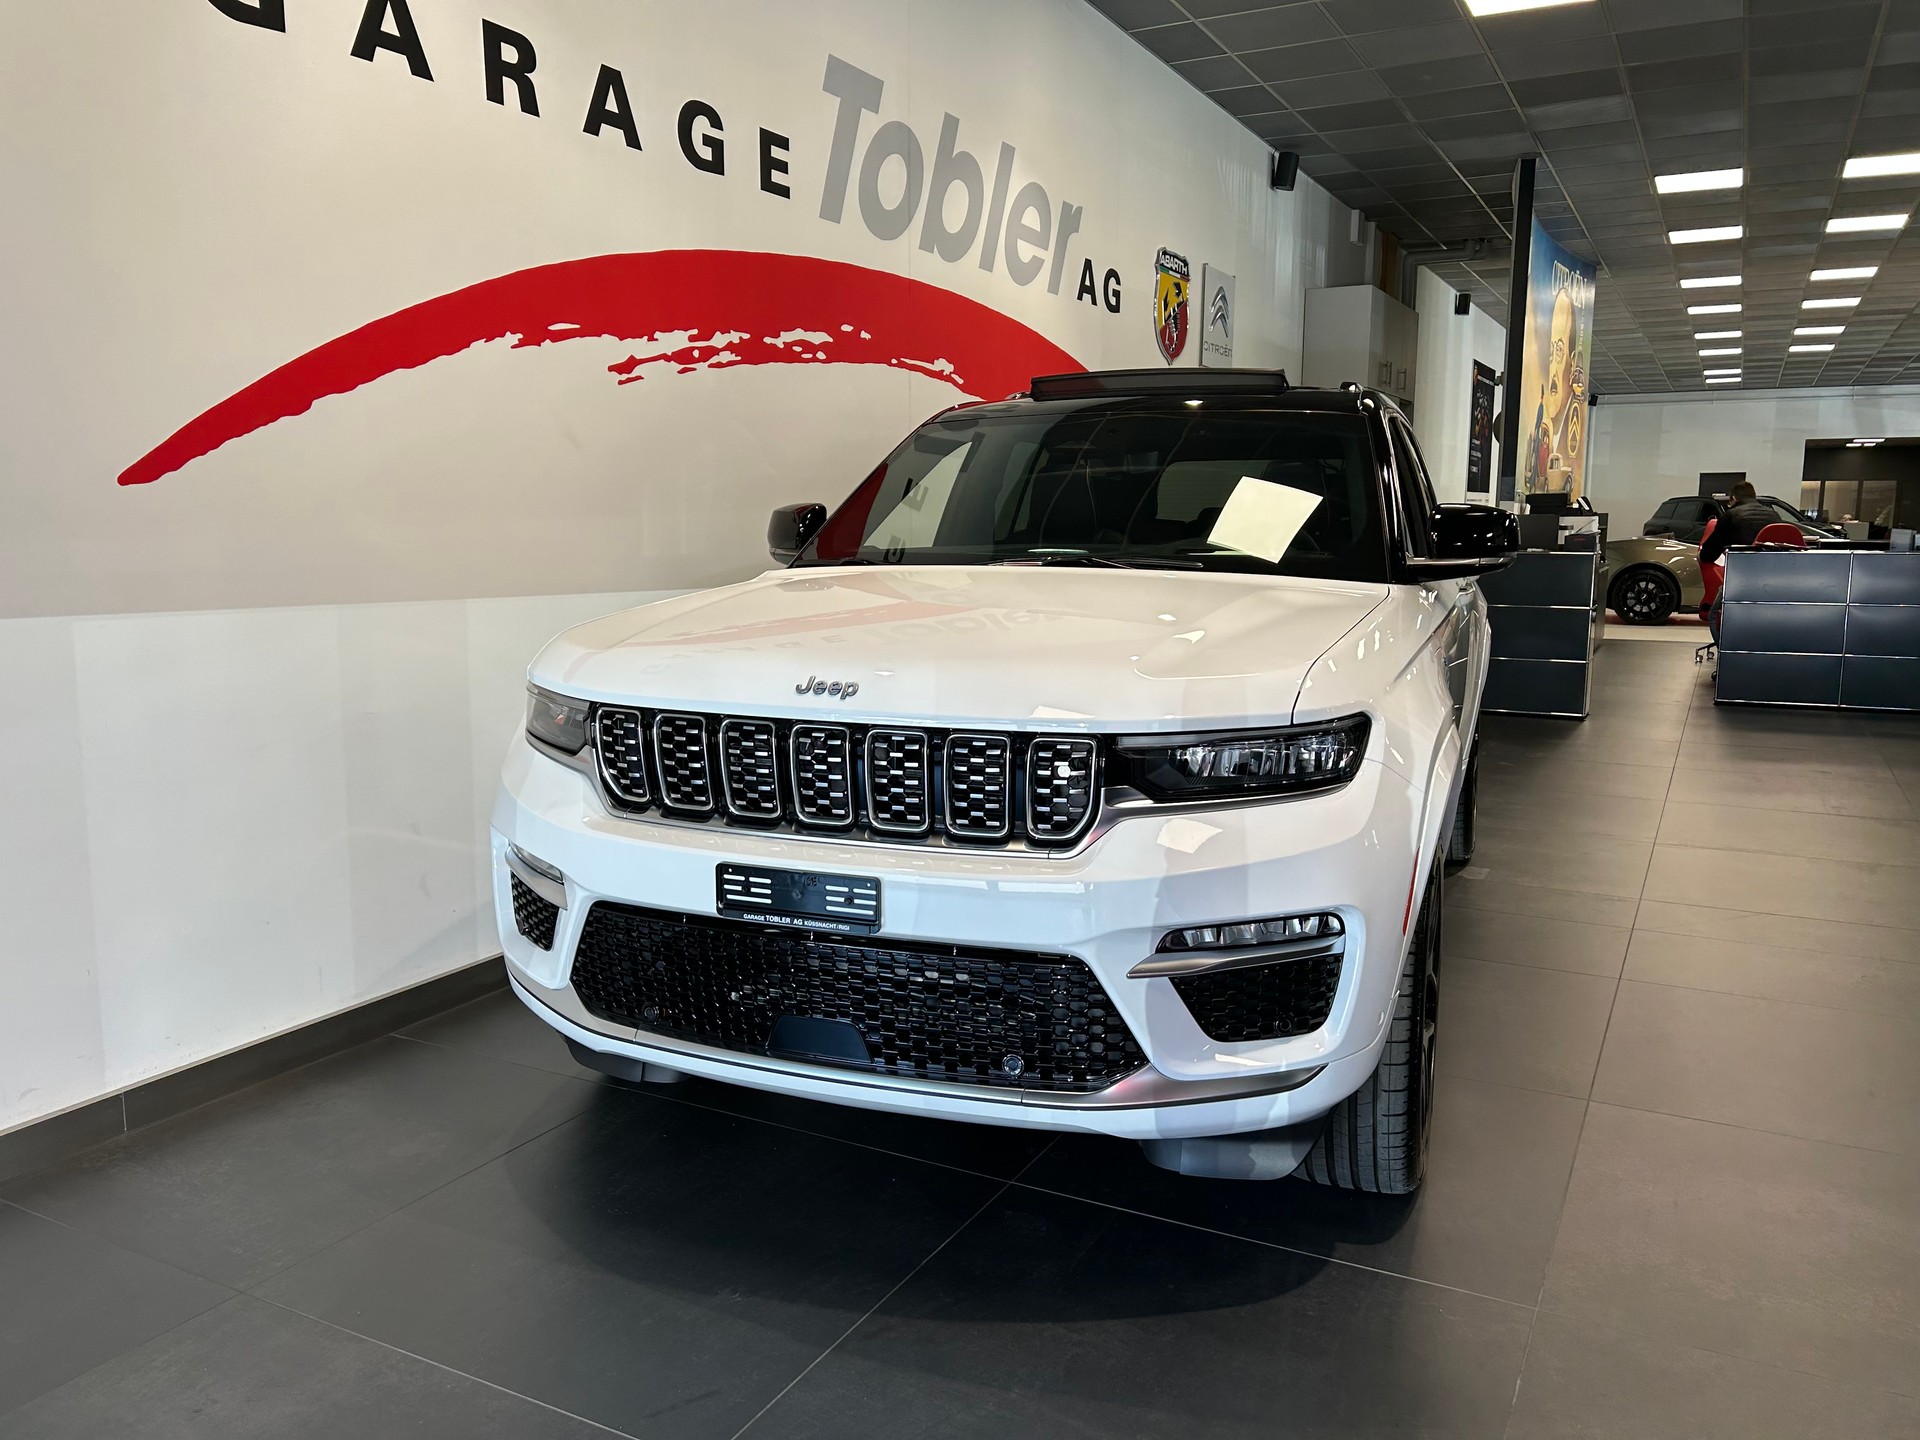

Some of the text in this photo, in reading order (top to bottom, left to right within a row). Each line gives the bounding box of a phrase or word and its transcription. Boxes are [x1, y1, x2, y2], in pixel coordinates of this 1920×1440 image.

[208, 0, 1122, 314] ARAGE Tobler AG
[1160, 254, 1188, 274] ABARTH
[1203, 341, 1232, 358] CITROËN
[795, 675, 860, 701] Jeep
[743, 913, 850, 930] GARAGE TOBLER AG KÜSSNACHT/RIGI
